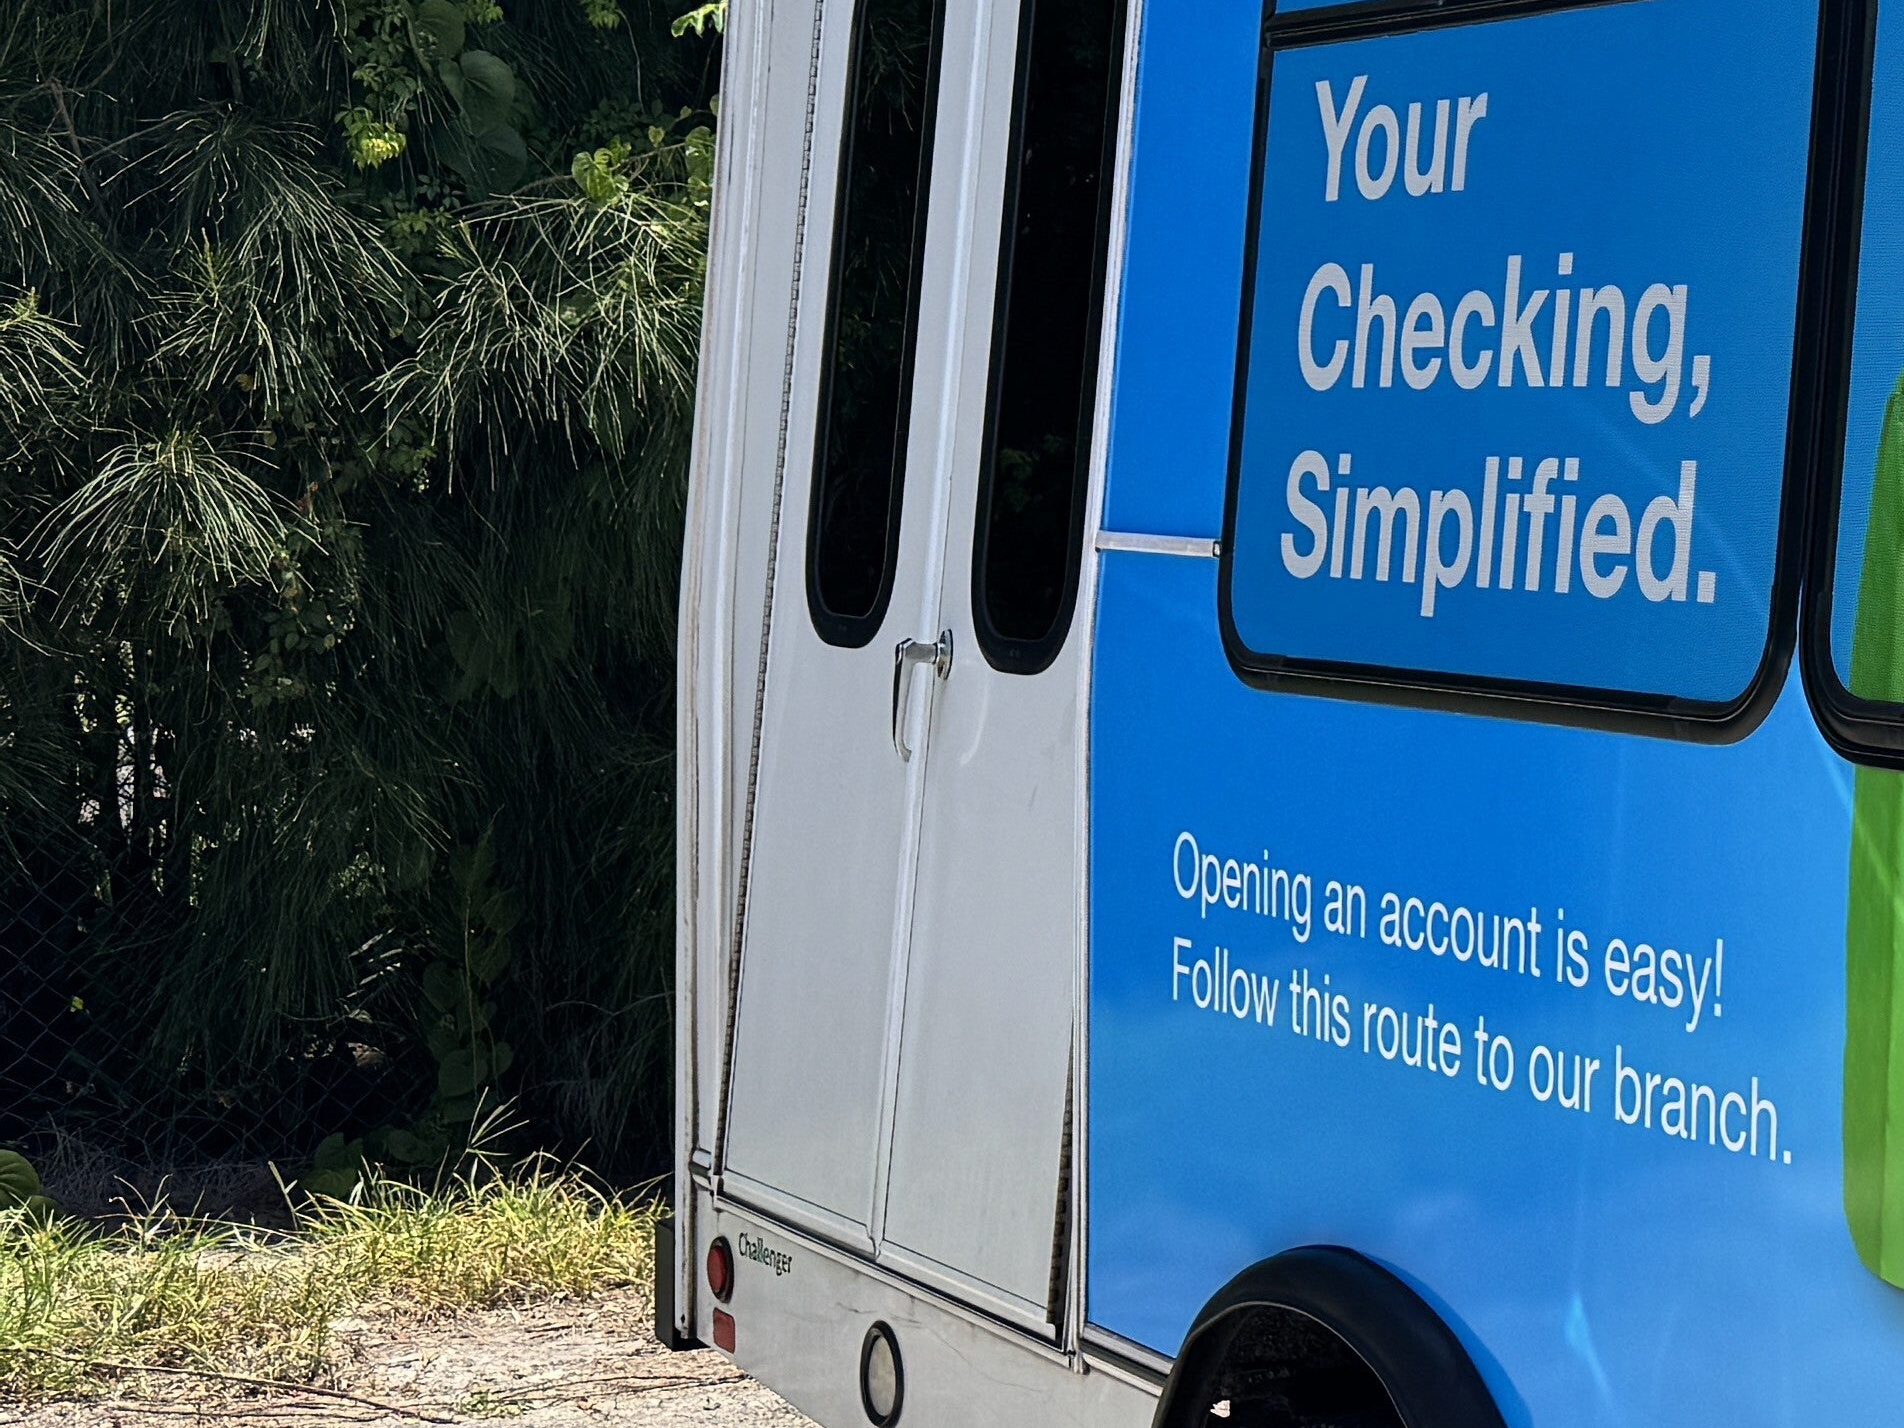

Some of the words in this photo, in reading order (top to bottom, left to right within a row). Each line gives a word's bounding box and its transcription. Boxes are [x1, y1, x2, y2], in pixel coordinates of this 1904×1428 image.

[1314, 73, 1489, 203] Your
[1296, 251, 1712, 425] Checking,
[1279, 449, 1719, 618] Simplified.
[1172, 831, 1312, 944] Opening
[1323, 879, 1367, 939] an
[1378, 890, 1543, 978] account
[1556, 906, 1590, 988] is
[1604, 937, 1724, 1034] easy!
[1171, 935, 1280, 1027] Follow
[1288, 967, 1351, 1048] this
[1363, 1001, 1462, 1078] route
[1473, 1014, 1515, 1092] to
[1528, 1044, 1601, 1113] our
[1614, 1043, 1793, 1165] branch.
[738, 1232, 793, 1277] Challenger
